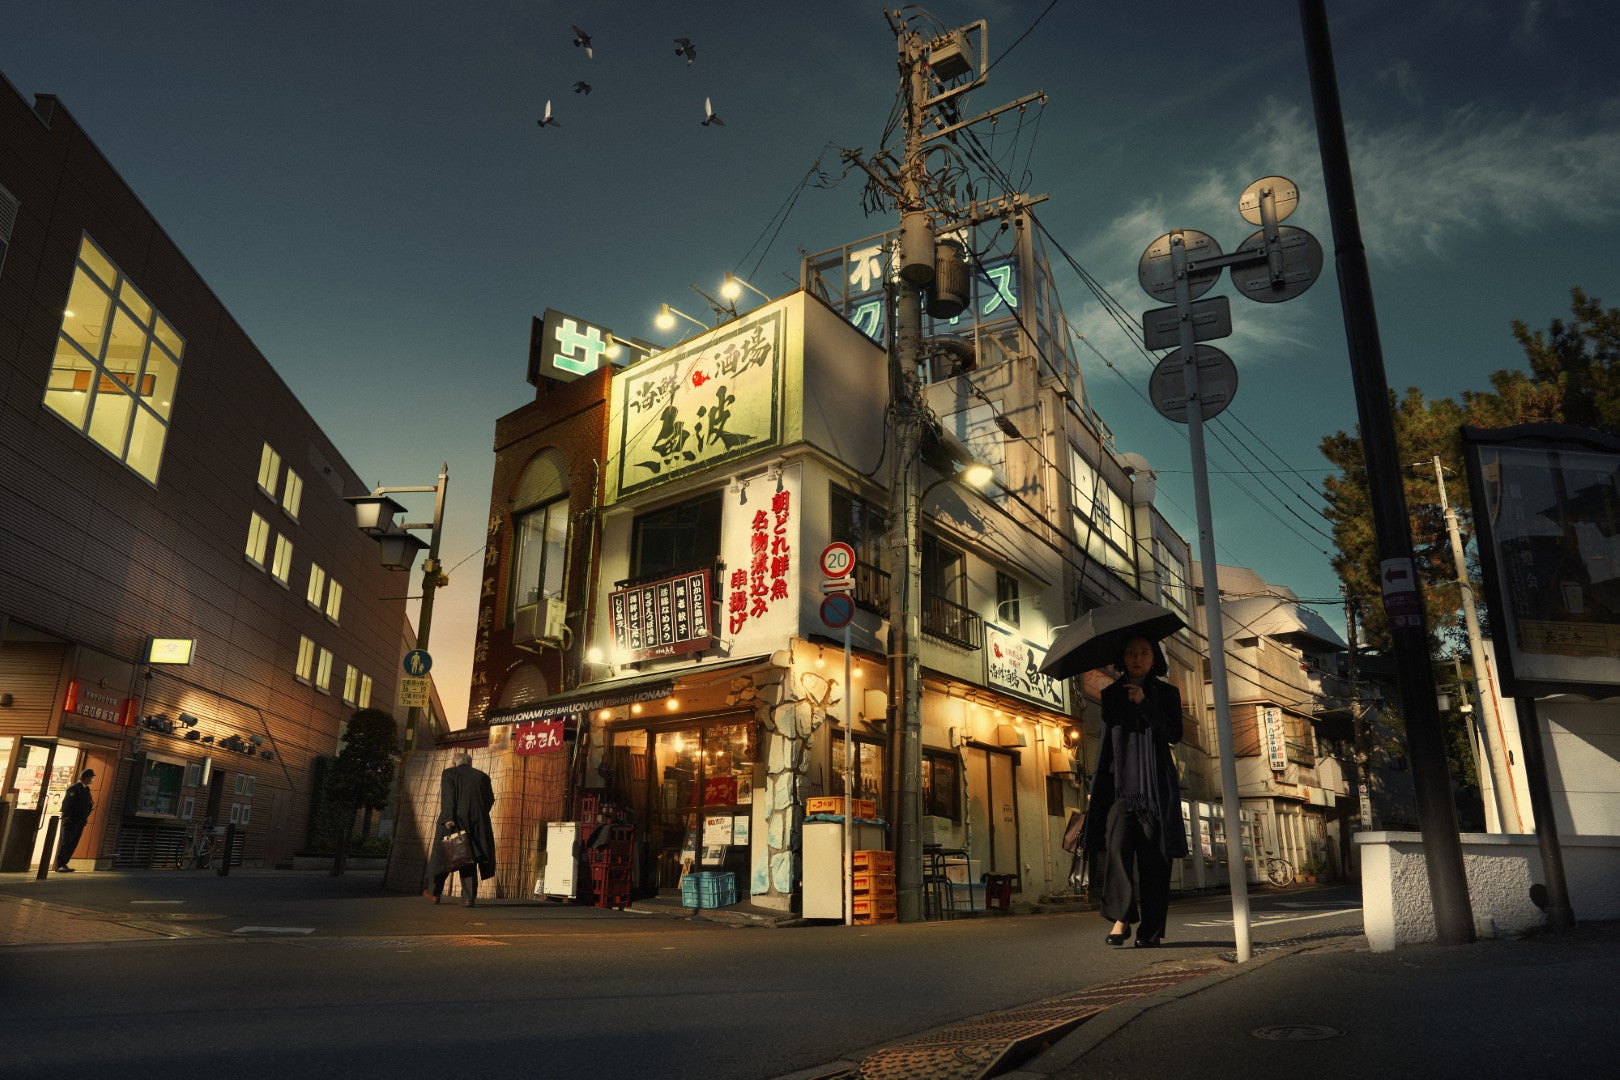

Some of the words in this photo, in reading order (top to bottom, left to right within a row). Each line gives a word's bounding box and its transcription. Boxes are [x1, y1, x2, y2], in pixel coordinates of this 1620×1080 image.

[553, 318, 605, 376] サ
[630, 363, 681, 413] 海鮮
[714, 325, 772, 380] 酒場
[633, 385, 758, 474] 魚波
[750, 509, 769, 618] 名物煮込み
[770, 490, 790, 601] 朝どれ鮮魚
[828, 553, 847, 568] 20
[729, 568, 748, 634] 串揚げ
[512, 709, 543, 721] UONAMI
[544, 708, 557, 716] FISH
[557, 706, 568, 715] BAR
[569, 699, 604, 713] UONAMI
[525, 729, 560, 749] おでん
